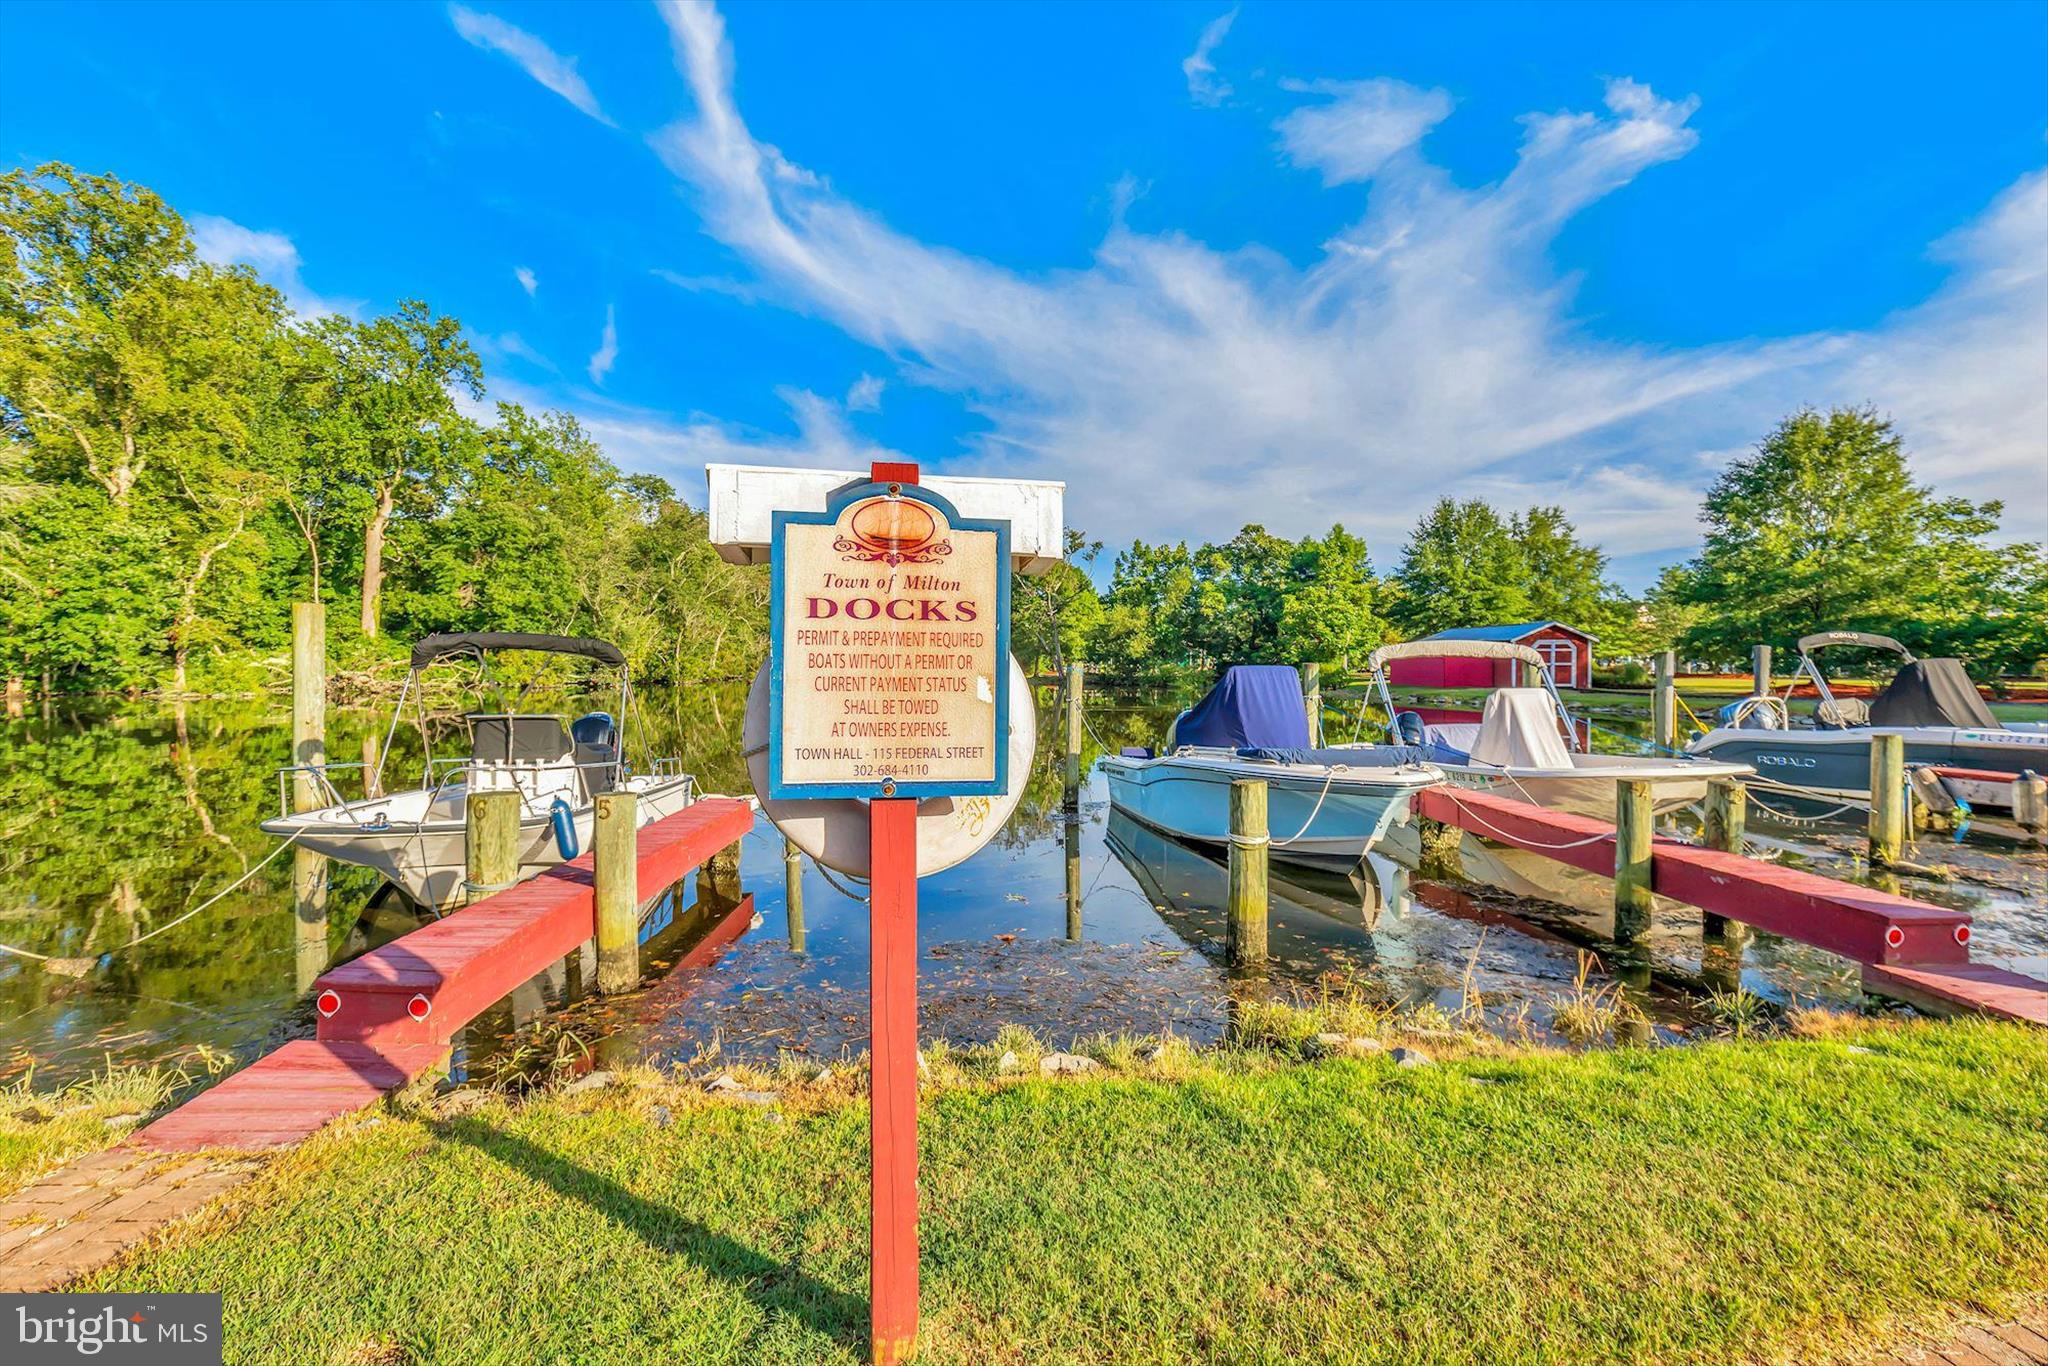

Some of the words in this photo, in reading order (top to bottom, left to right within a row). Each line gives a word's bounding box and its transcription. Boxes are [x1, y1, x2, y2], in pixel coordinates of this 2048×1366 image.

[823, 573, 870, 590] Town
[877, 574, 896, 594] of
[903, 574, 961, 592] Milton
[806, 597, 978, 623] DOCKS
[797, 629, 840, 647] PERMIT
[841, 631, 850, 647] &
[852, 631, 927, 648] PREPAYMENT
[929, 632, 984, 649] REQUIRED
[808, 653, 846, 670] BOATS
[849, 653, 902, 671] WITHOUT
[904, 654, 913, 671] A
[914, 654, 955, 671] PERMIT
[957, 654, 974, 671] OR
[814, 675, 867, 693] CURRENT
[869, 676, 924, 693] PAYMENT
[926, 676, 968, 693] STATUS
[843, 699, 879, 716] SHALL
[882, 699, 896, 716] BE
[898, 699, 939, 716] TOWED
[831, 722, 846, 738] AT
[848, 722, 898, 739] OWNERS
[900, 722, 952, 739] EXPENSE.
[795, 747, 832, 762] TOWN
[833, 748, 863, 762] HALL
[873, 748, 892, 761] 115
[895, 748, 944, 761] FEDERAL
[946, 747, 985, 761] STREET
[1756, 755, 1817, 768] ROBALO
[853, 764, 929, 777] 302-684-4110
[474, 800, 487, 820] 6
[598, 800, 611, 819] 5
